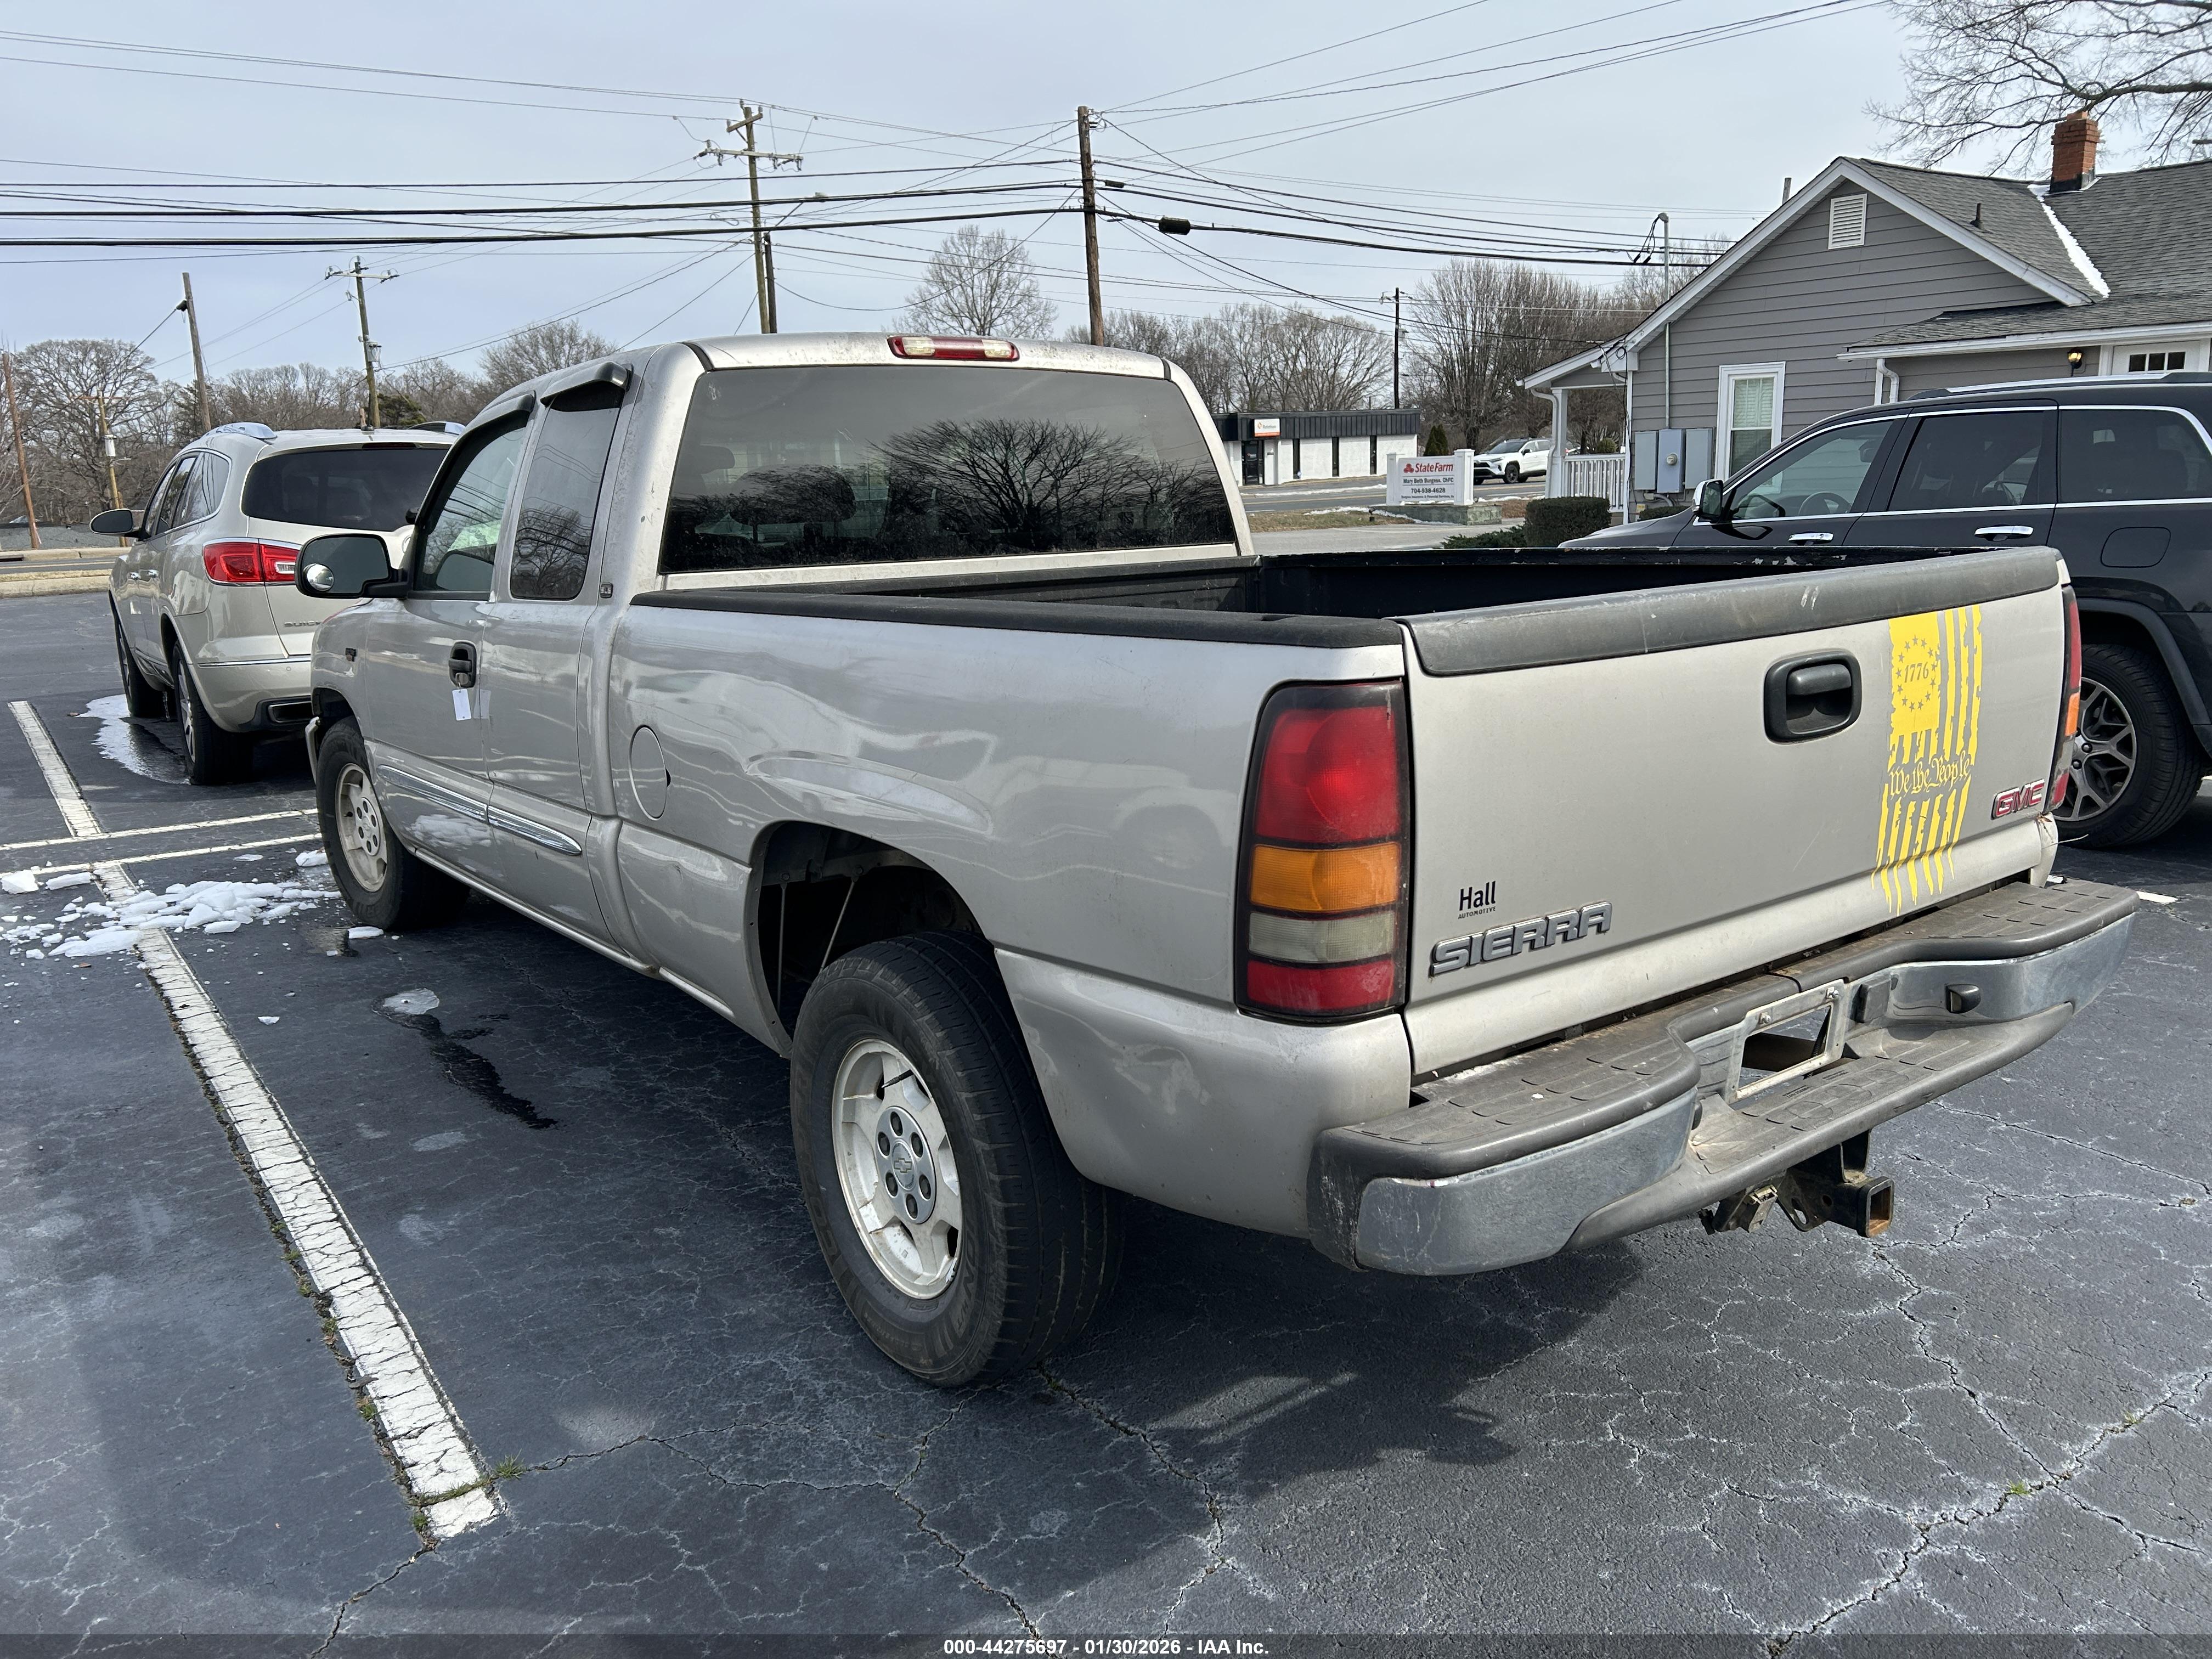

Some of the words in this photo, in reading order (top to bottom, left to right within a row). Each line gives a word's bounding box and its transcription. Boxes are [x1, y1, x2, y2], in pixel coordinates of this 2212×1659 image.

[1415, 463, 1434, 473] State
[1435, 462, 1454, 472] Farm
[1904, 662, 1929, 683] 1776
[1889, 766, 1911, 797] We
[1911, 761, 1931, 793] the
[1928, 750, 1971, 792] People
[1991, 778, 2045, 819] GMC
[1459, 881, 1496, 911] Hall
[1458, 906, 1496, 919] AUTOMOTIVE
[1429, 900, 1612, 977] SIERRA
